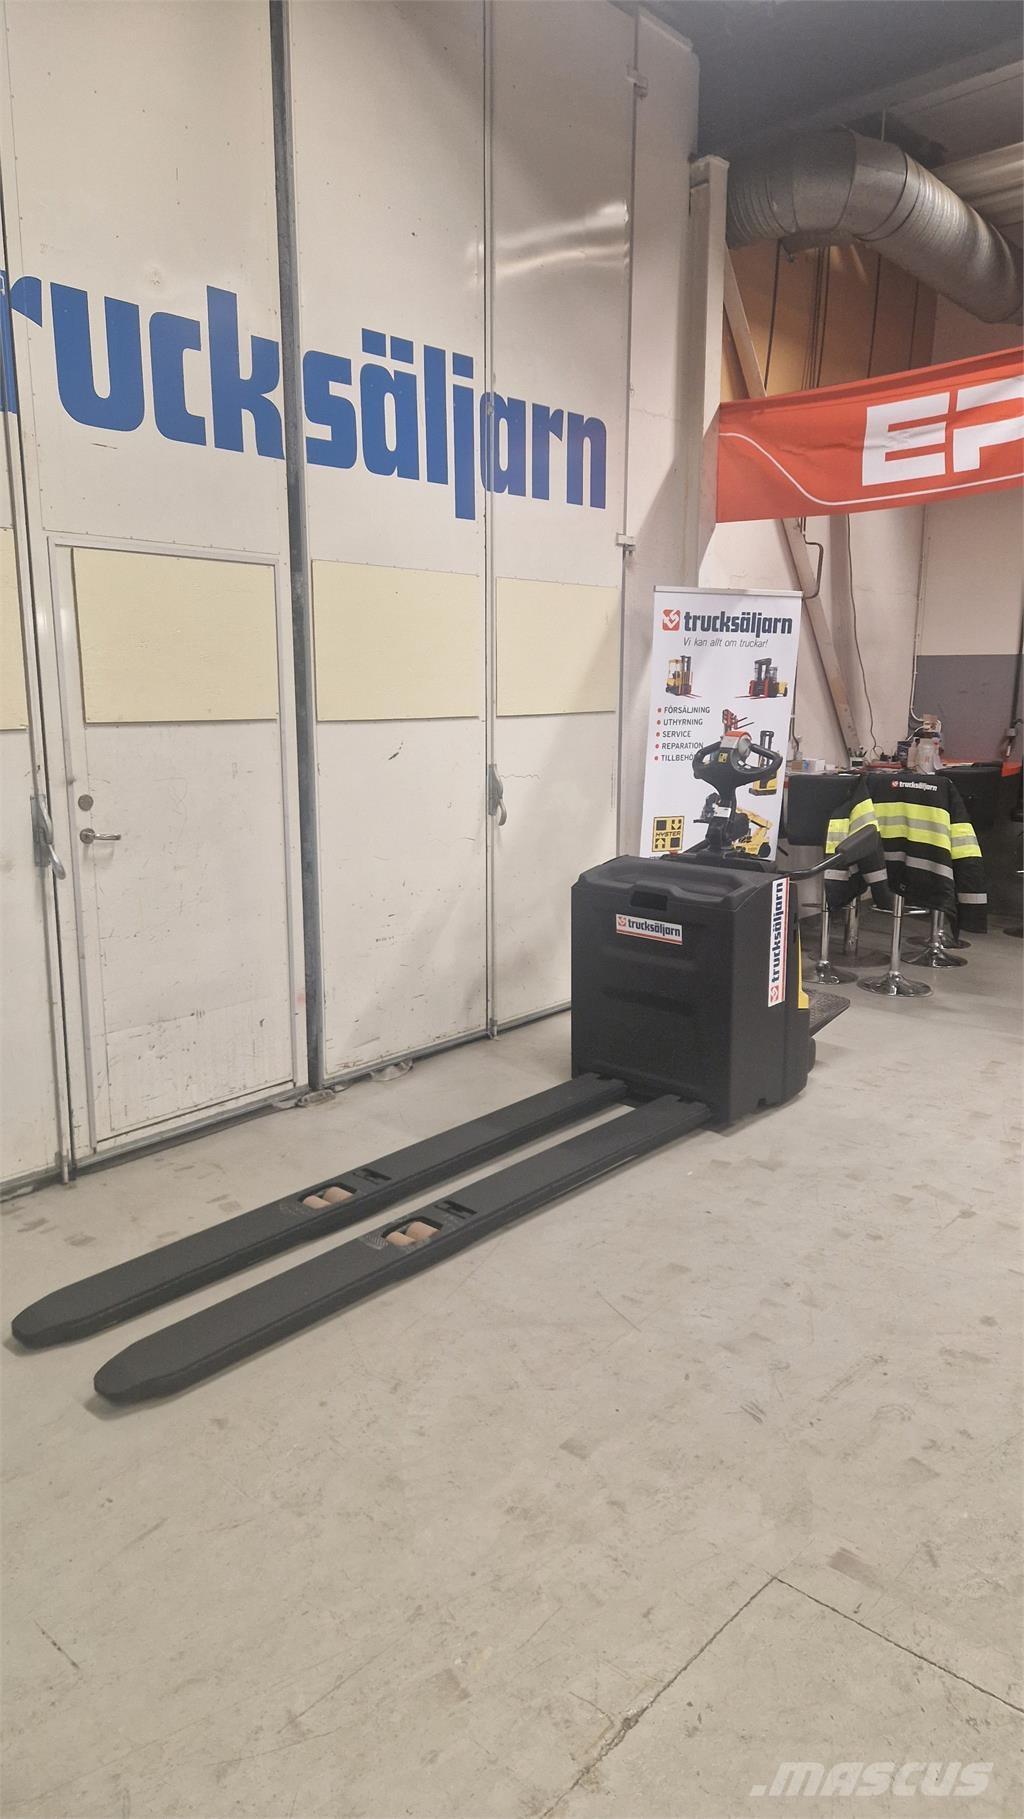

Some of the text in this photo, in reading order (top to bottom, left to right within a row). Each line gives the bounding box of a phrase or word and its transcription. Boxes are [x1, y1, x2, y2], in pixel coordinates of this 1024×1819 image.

[684, 611, 792, 638] trucksäljarn
[683, 637, 691, 646] Vi
[694, 637, 707, 647] kan
[710, 638, 722, 647] allt
[740, 639, 768, 648] truckar!
[664, 704, 710, 714] FÖRSÄLJNING
[663, 718, 703, 726] UTHYRNING
[662, 730, 692, 738] SERVICE
[661, 742, 704, 750] REPARATION
[628, 919, 681, 937] trucksäljarn
[772, 882, 784, 983] trucksäljarn
